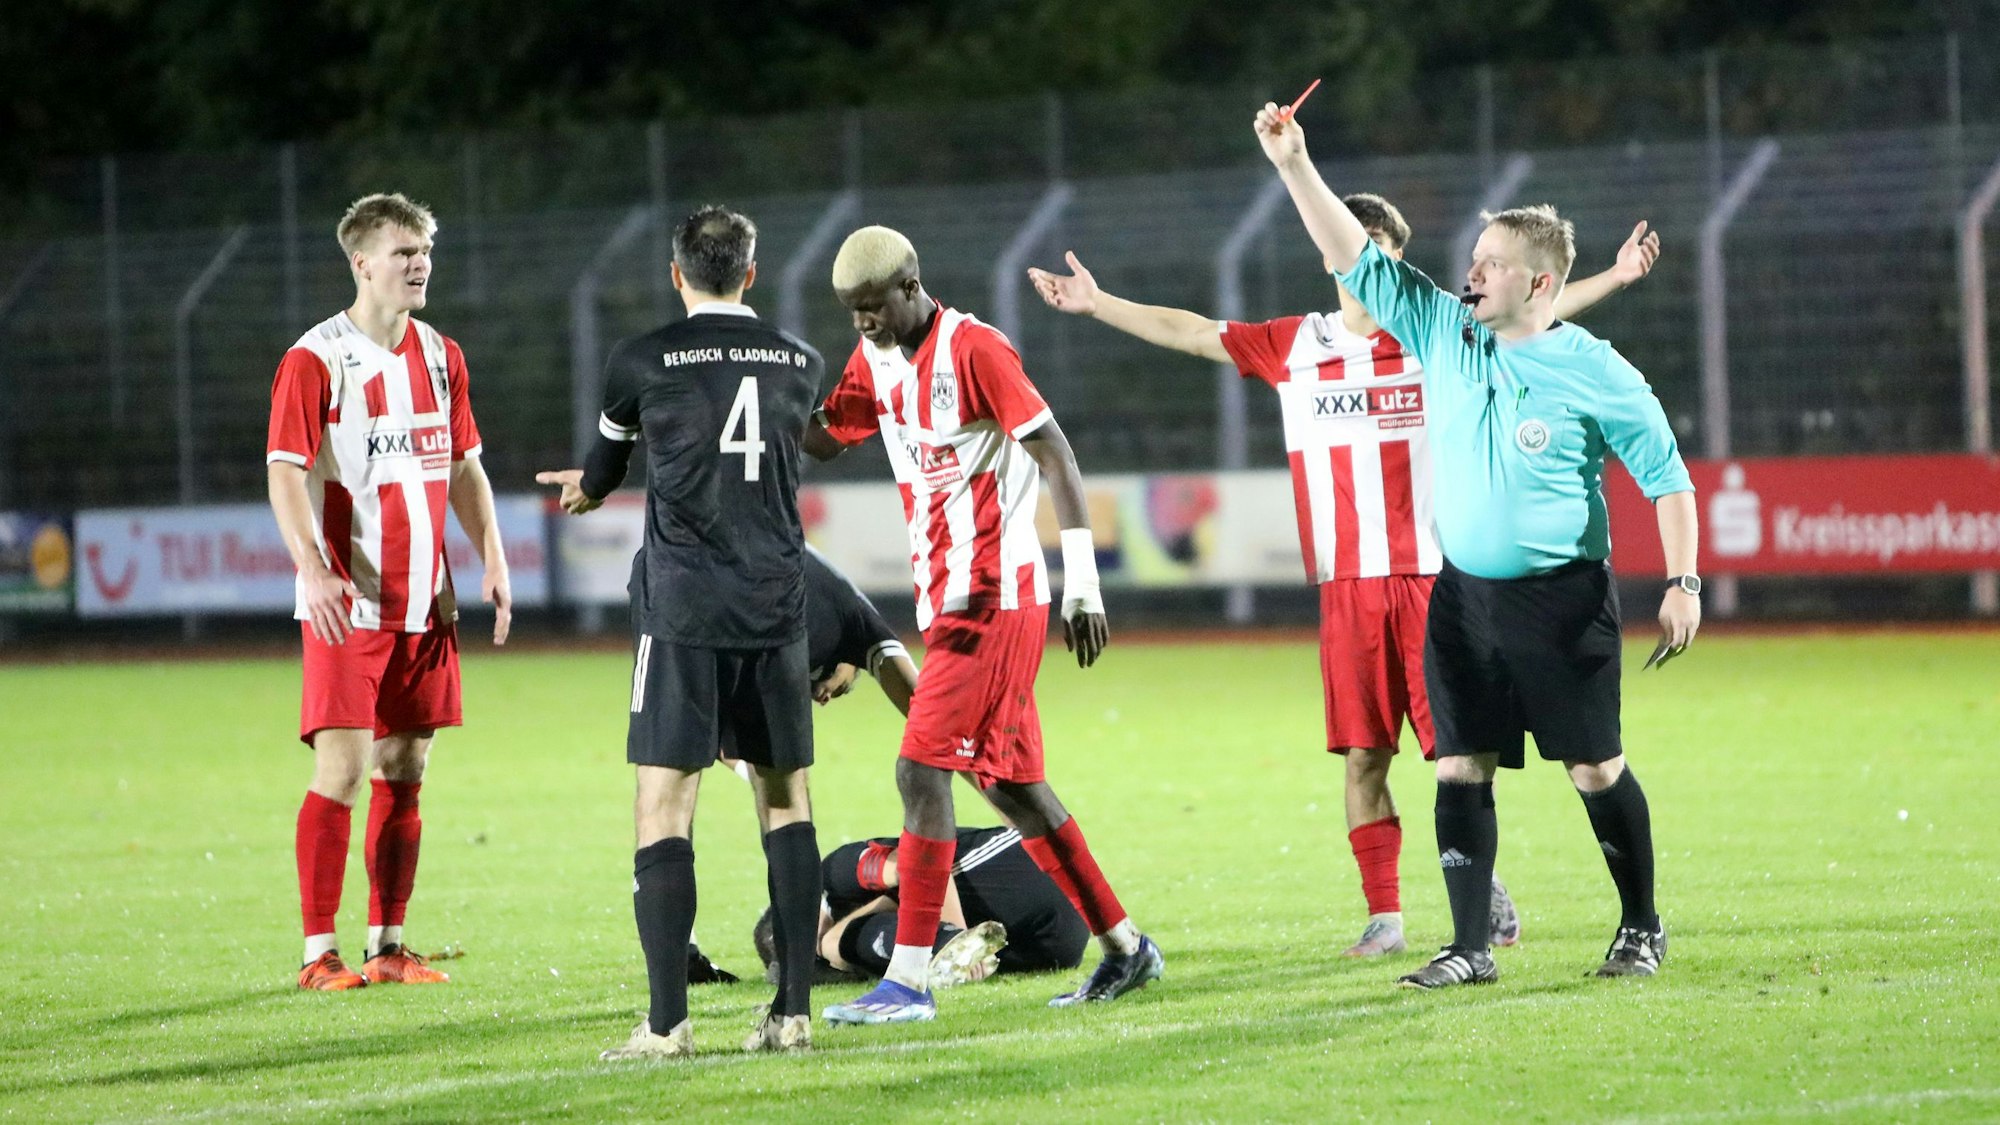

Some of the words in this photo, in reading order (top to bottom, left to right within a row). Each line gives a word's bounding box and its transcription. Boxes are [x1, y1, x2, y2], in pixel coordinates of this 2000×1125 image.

[663, 348, 723, 367] BERGISCH
[729, 348, 790, 365] GLADBACH
[794, 353, 807, 368] 09
[1315, 389, 1419, 415] XXXLutz
[719, 376, 766, 481] 4
[1380, 417, 1423, 428] müllerland
